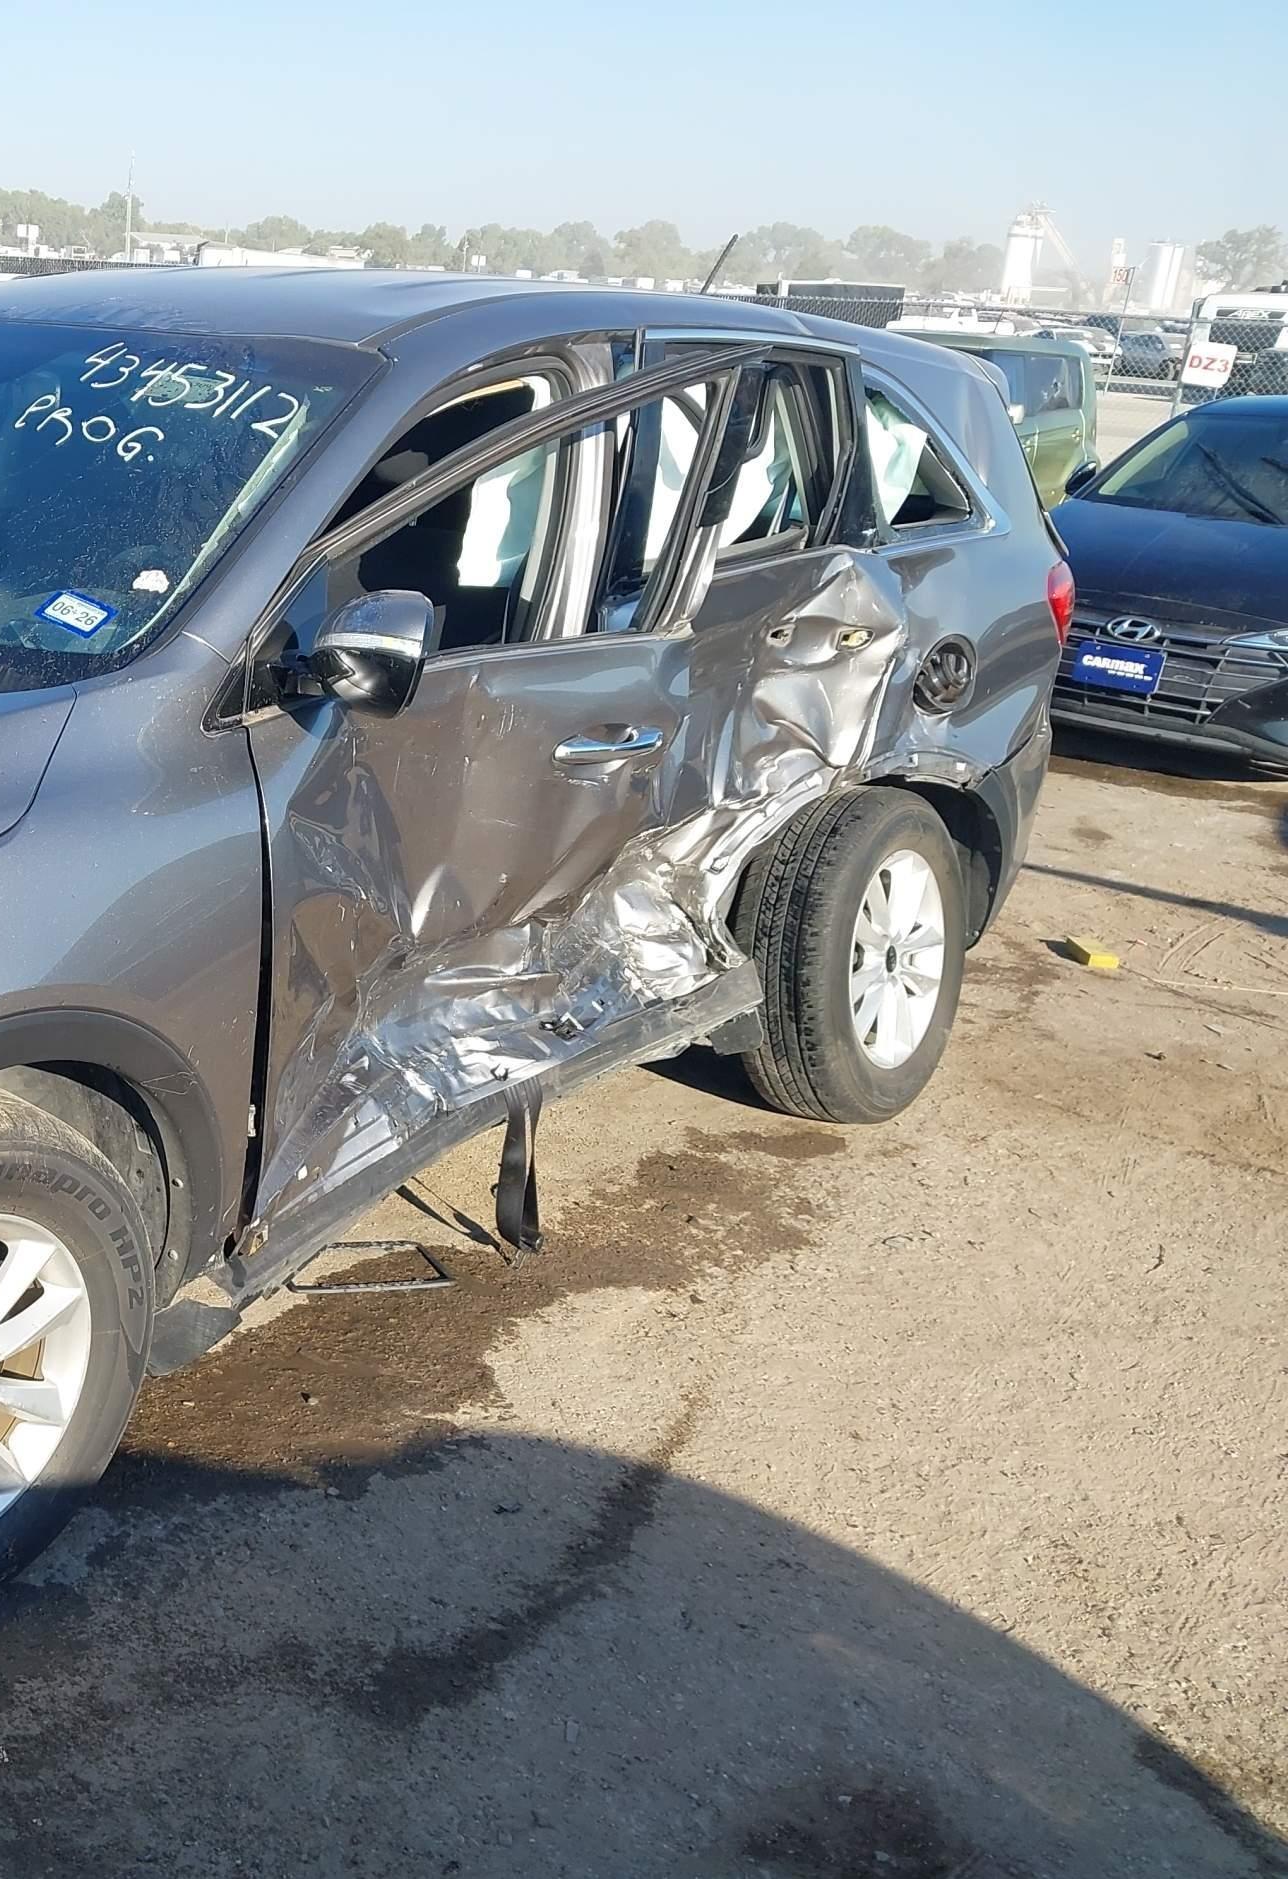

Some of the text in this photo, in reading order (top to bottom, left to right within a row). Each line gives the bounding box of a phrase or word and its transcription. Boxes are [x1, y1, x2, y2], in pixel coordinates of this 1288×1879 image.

[80, 342, 301, 439] 43453112
[1188, 355, 1230, 374] DZ3
[14, 394, 165, 462] PROG.
